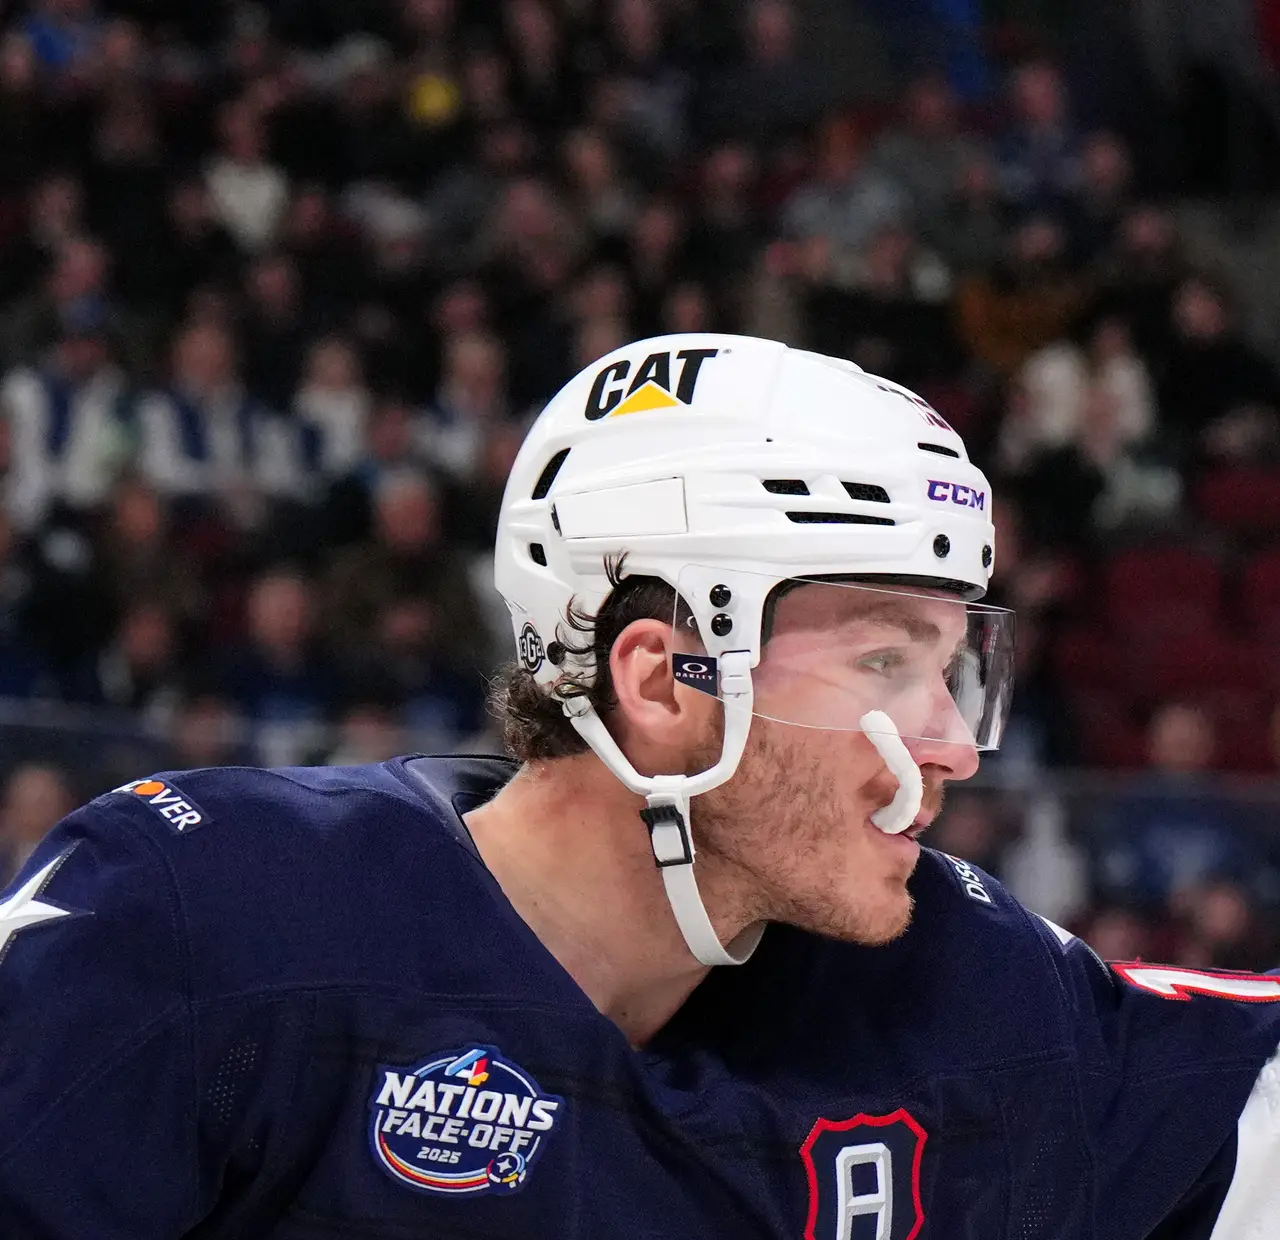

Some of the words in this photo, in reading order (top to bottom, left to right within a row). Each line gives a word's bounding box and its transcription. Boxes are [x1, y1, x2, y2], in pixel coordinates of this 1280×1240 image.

[585, 349, 718, 421] CAT
[927, 479, 985, 511] CCM
[675, 671, 714, 681] OAKLEY
[375, 1071, 560, 1132] NATIONS
[381, 1108, 534, 1154] FACE-OFF
[416, 1146, 462, 1164] 2025
